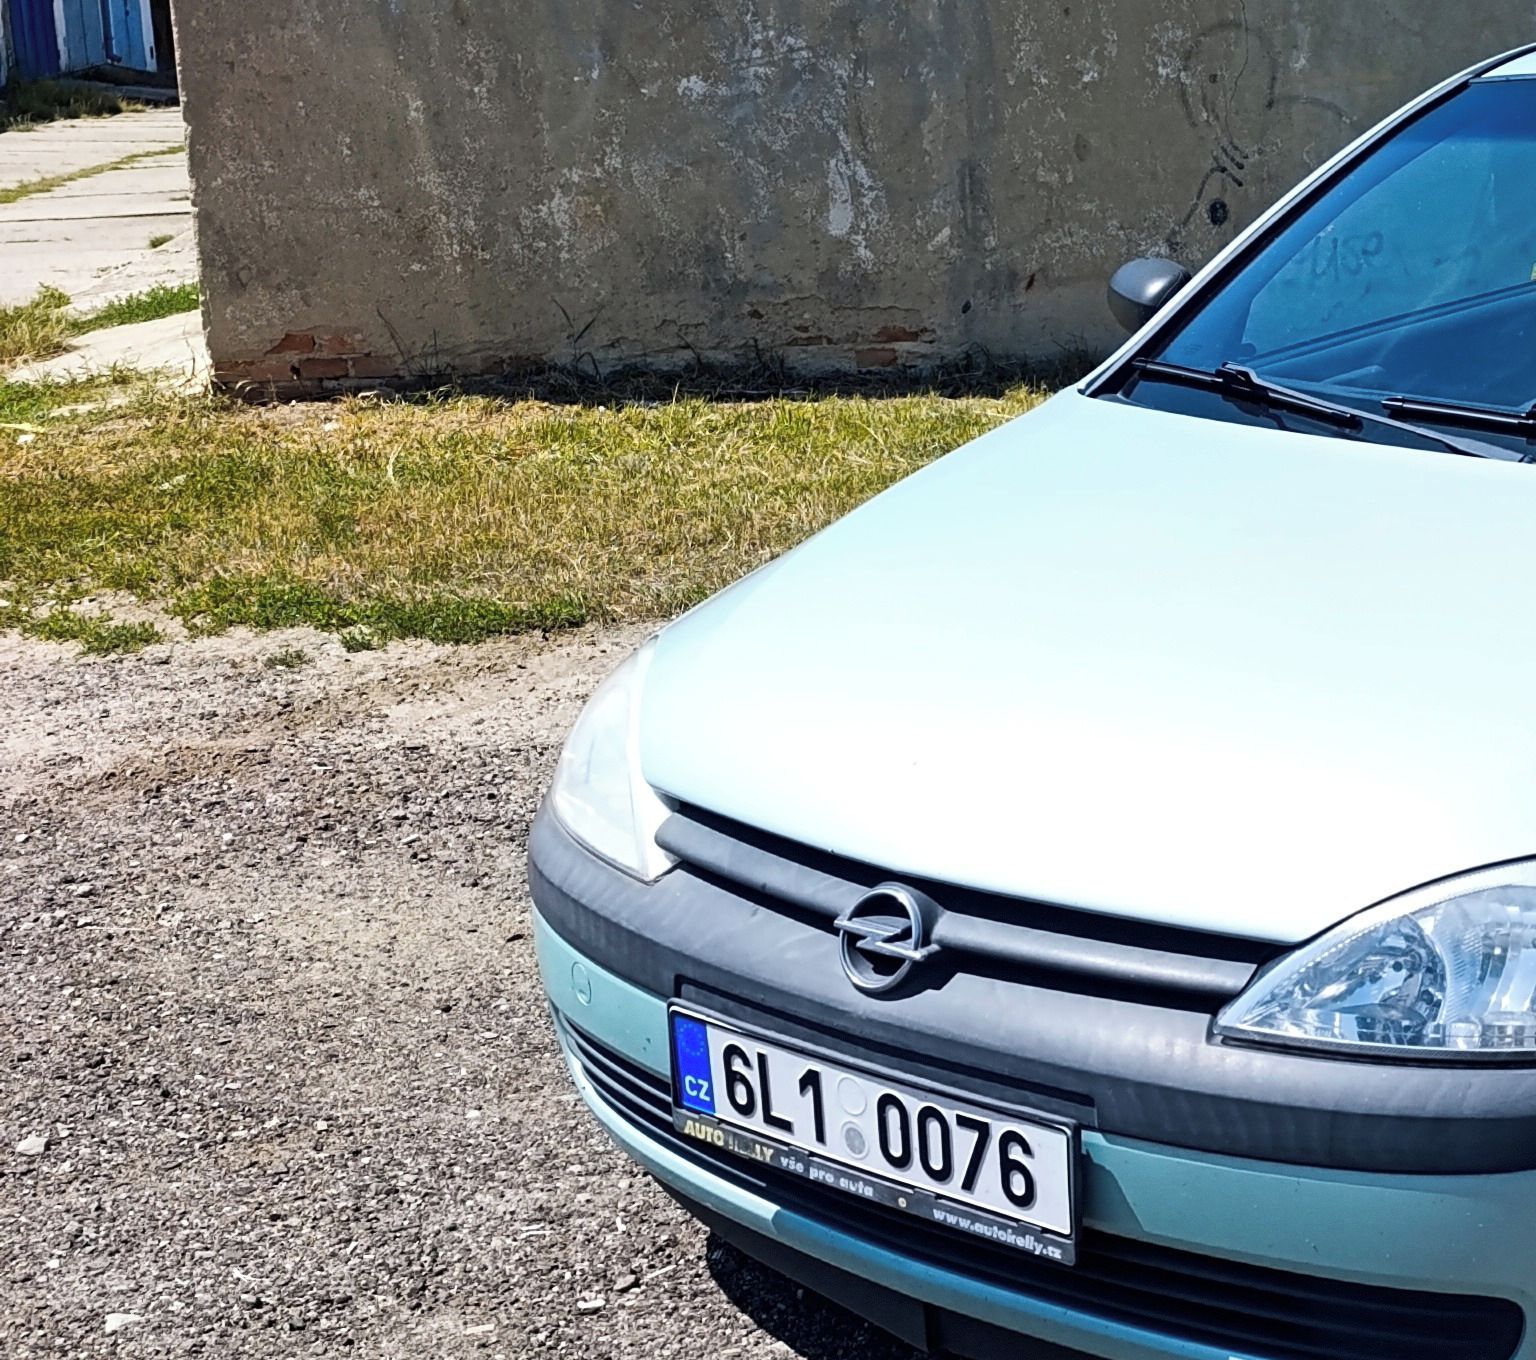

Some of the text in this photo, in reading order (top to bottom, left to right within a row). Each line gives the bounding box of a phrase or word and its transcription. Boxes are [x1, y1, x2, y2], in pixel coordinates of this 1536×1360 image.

[684, 1074, 711, 1103] CZ
[683, 1119, 724, 1147] AUTO
[722, 1043, 1036, 1209] 6L1 0076
[780, 1156, 874, 1197] vše pro auta
[933, 1208, 1062, 1259] www.autokelly.cz
